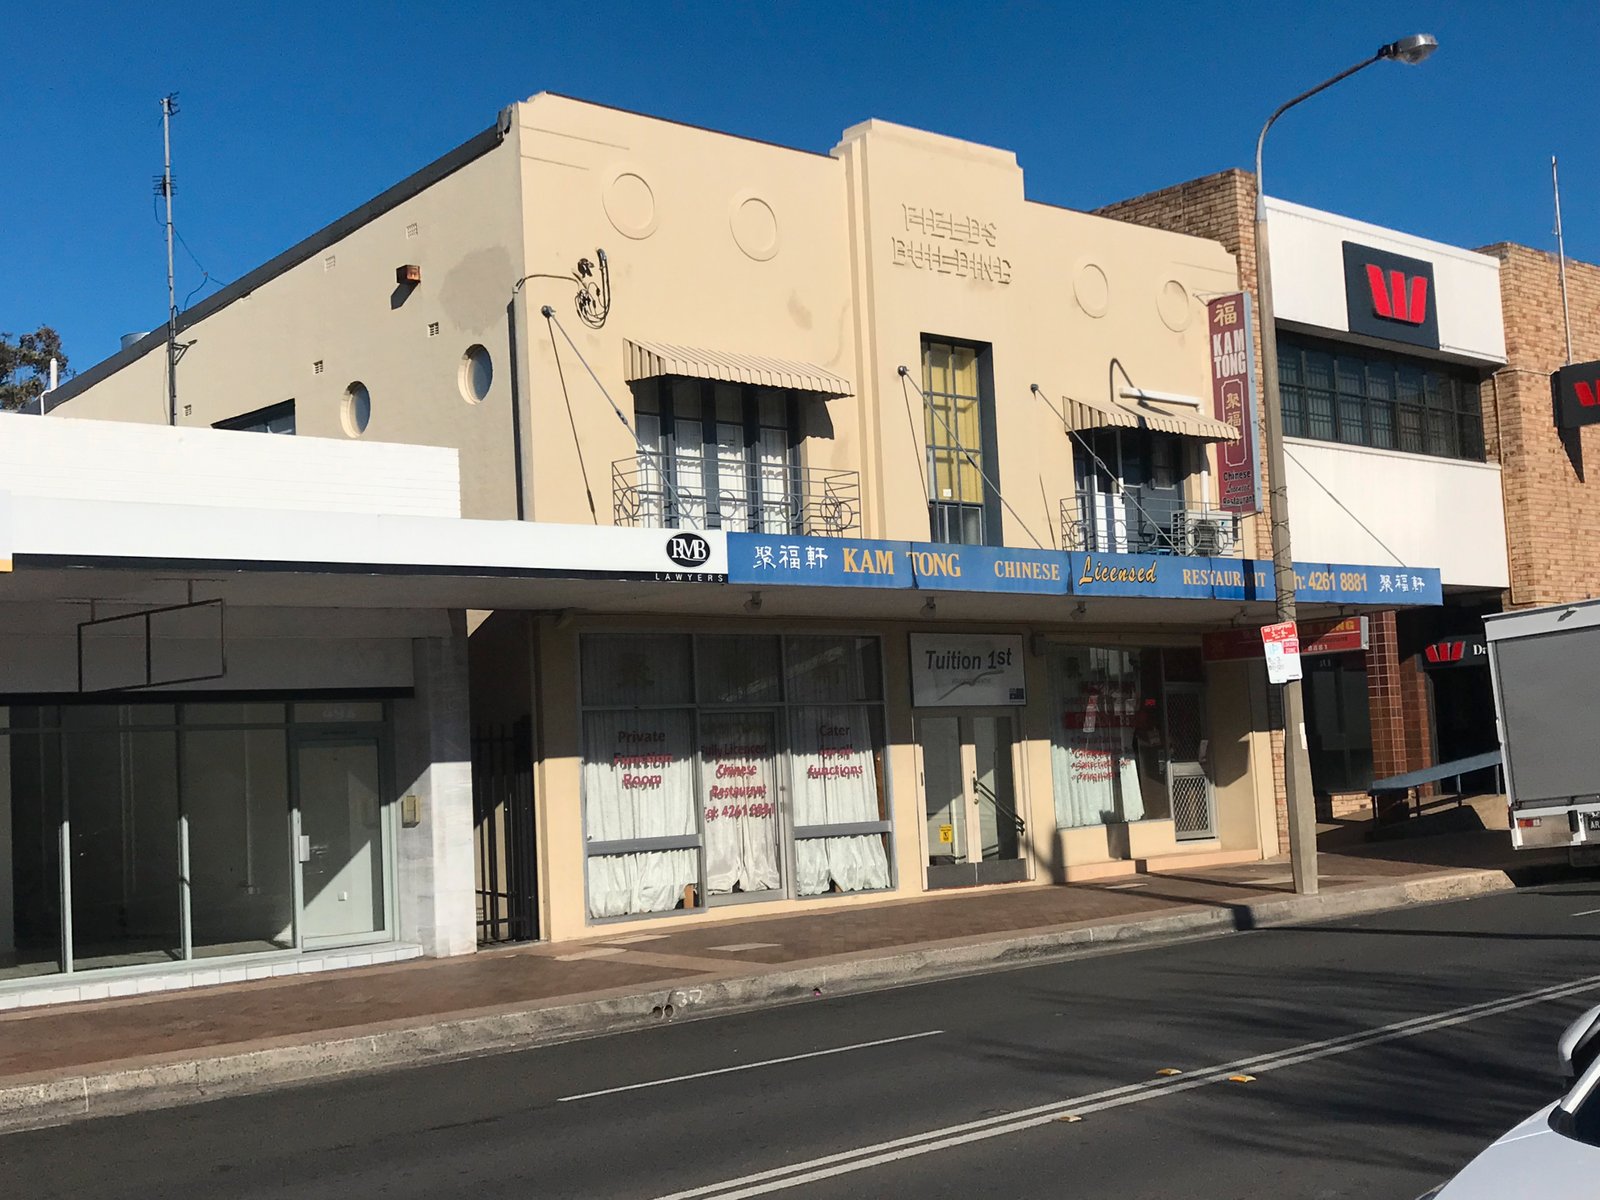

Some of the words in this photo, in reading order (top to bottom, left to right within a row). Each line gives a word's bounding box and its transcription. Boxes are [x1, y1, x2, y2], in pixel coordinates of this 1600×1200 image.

[901, 203, 997, 247] FIELDS
[892, 236, 1012, 285] BUILDING
[1213, 300, 1237, 327] 福
[1212, 328, 1245, 357] KAM
[1213, 351, 1247, 379] TONG
[1223, 470, 1251, 481] Chinese
[671, 538, 707, 561] RMB
[752, 544, 829, 570] 聚福軒
[655, 572, 724, 582] LAWYERS
[842, 547, 895, 575] KAM
[905, 551, 961, 577] TONG
[994, 560, 1061, 581] CHINESE
[1078, 554, 1158, 587] Licensed
[1308, 571, 1337, 591] 4261
[1340, 572, 1368, 592] 8881
[1378, 574, 1426, 593] 聚福軒
[925, 650, 981, 670] Tuition
[988, 648, 1012, 669] 1st
[617, 730, 666, 743] Private
[820, 725, 850, 737] Cater
[613, 752, 673, 768] Function
[716, 763, 757, 779] Chinese
[807, 764, 863, 777] functions
[623, 773, 662, 788] Room
[710, 784, 767, 799] Restaurant
[722, 804, 748, 818] 4261
